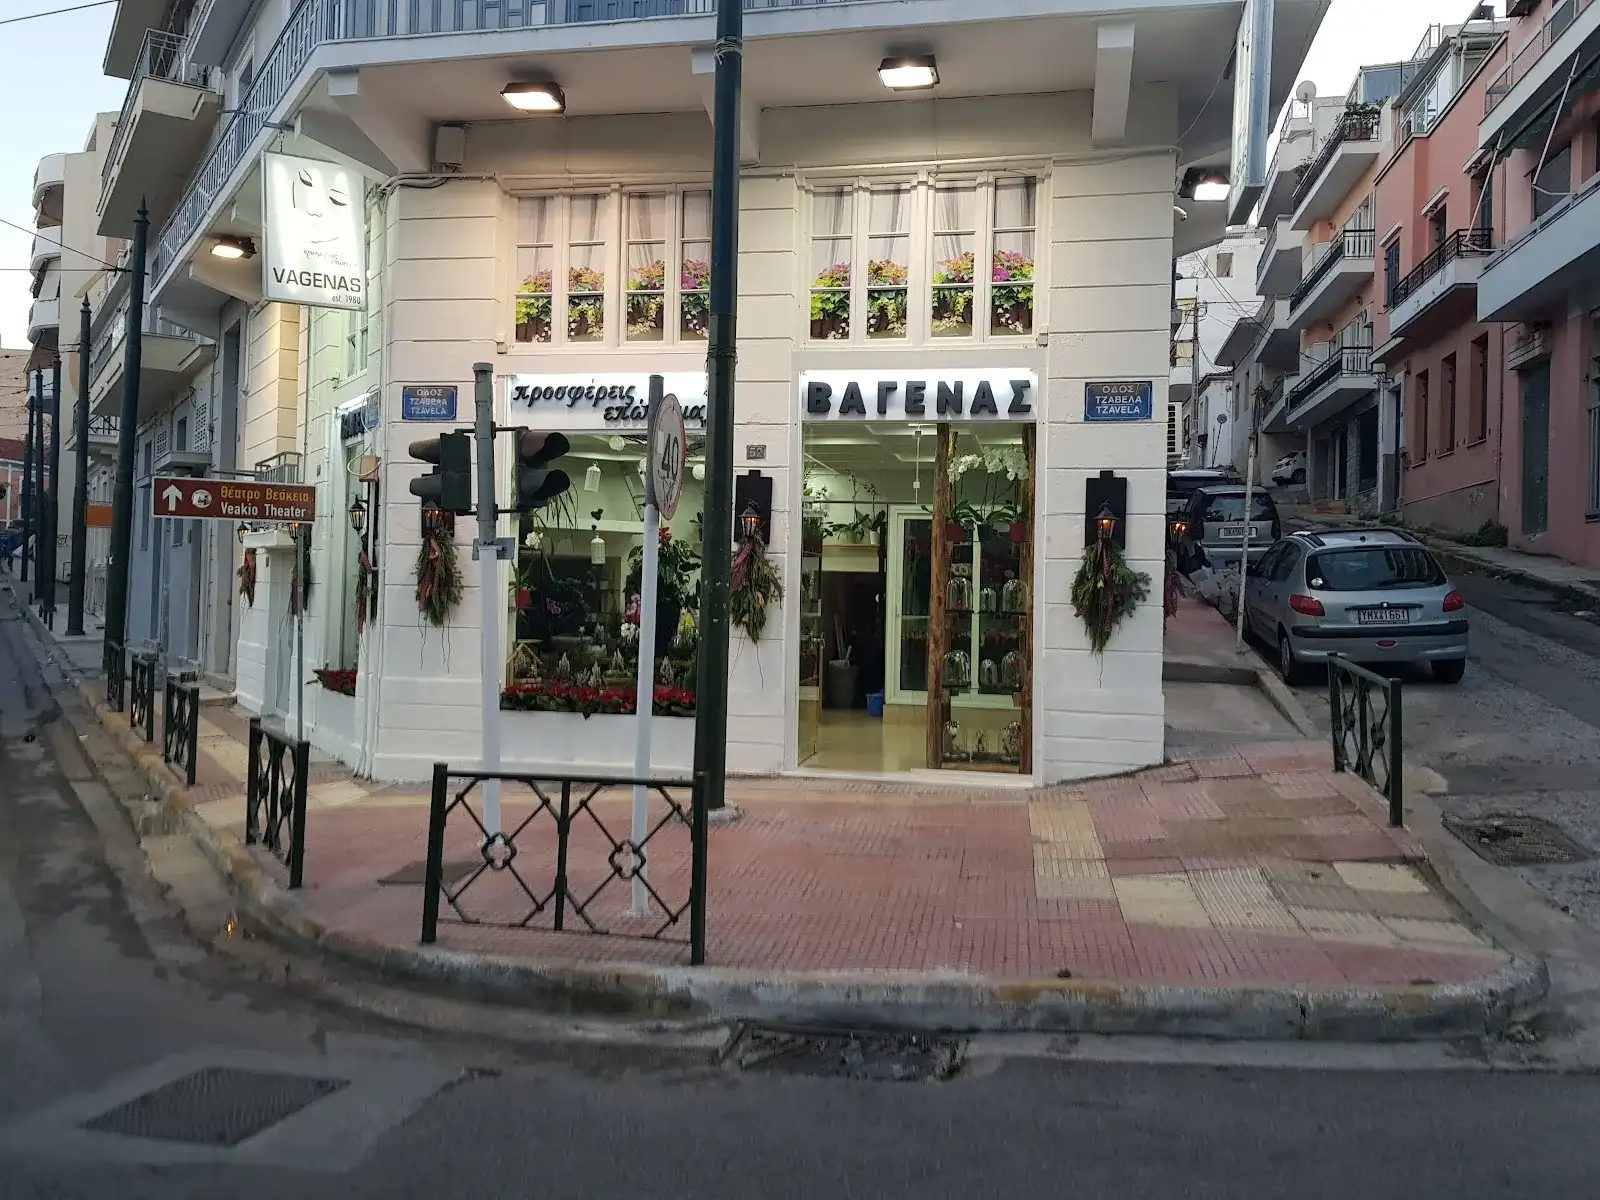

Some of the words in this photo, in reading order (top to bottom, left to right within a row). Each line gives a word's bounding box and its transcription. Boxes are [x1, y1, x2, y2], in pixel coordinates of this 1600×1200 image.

[272, 267, 361, 292] VAGENAS
[416, 388, 443, 396] ΟΔΟΣ
[512, 378, 636, 408] προσφέρεις
[807, 379, 1032, 414] ΒΑΓΕΝΑΣ
[1102, 385, 1135, 393] ΟΔΟΣ
[1095, 395, 1142, 404] ΤΖΑΒΕΛΑ
[410, 406, 447, 415] TZAVELA
[1096, 405, 1140, 414] TZAVELA
[661, 433, 680, 481] 40
[265, 487, 309, 502] Βεάκειο
[220, 501, 259, 515] Veakio
[264, 503, 307, 518] Theater
